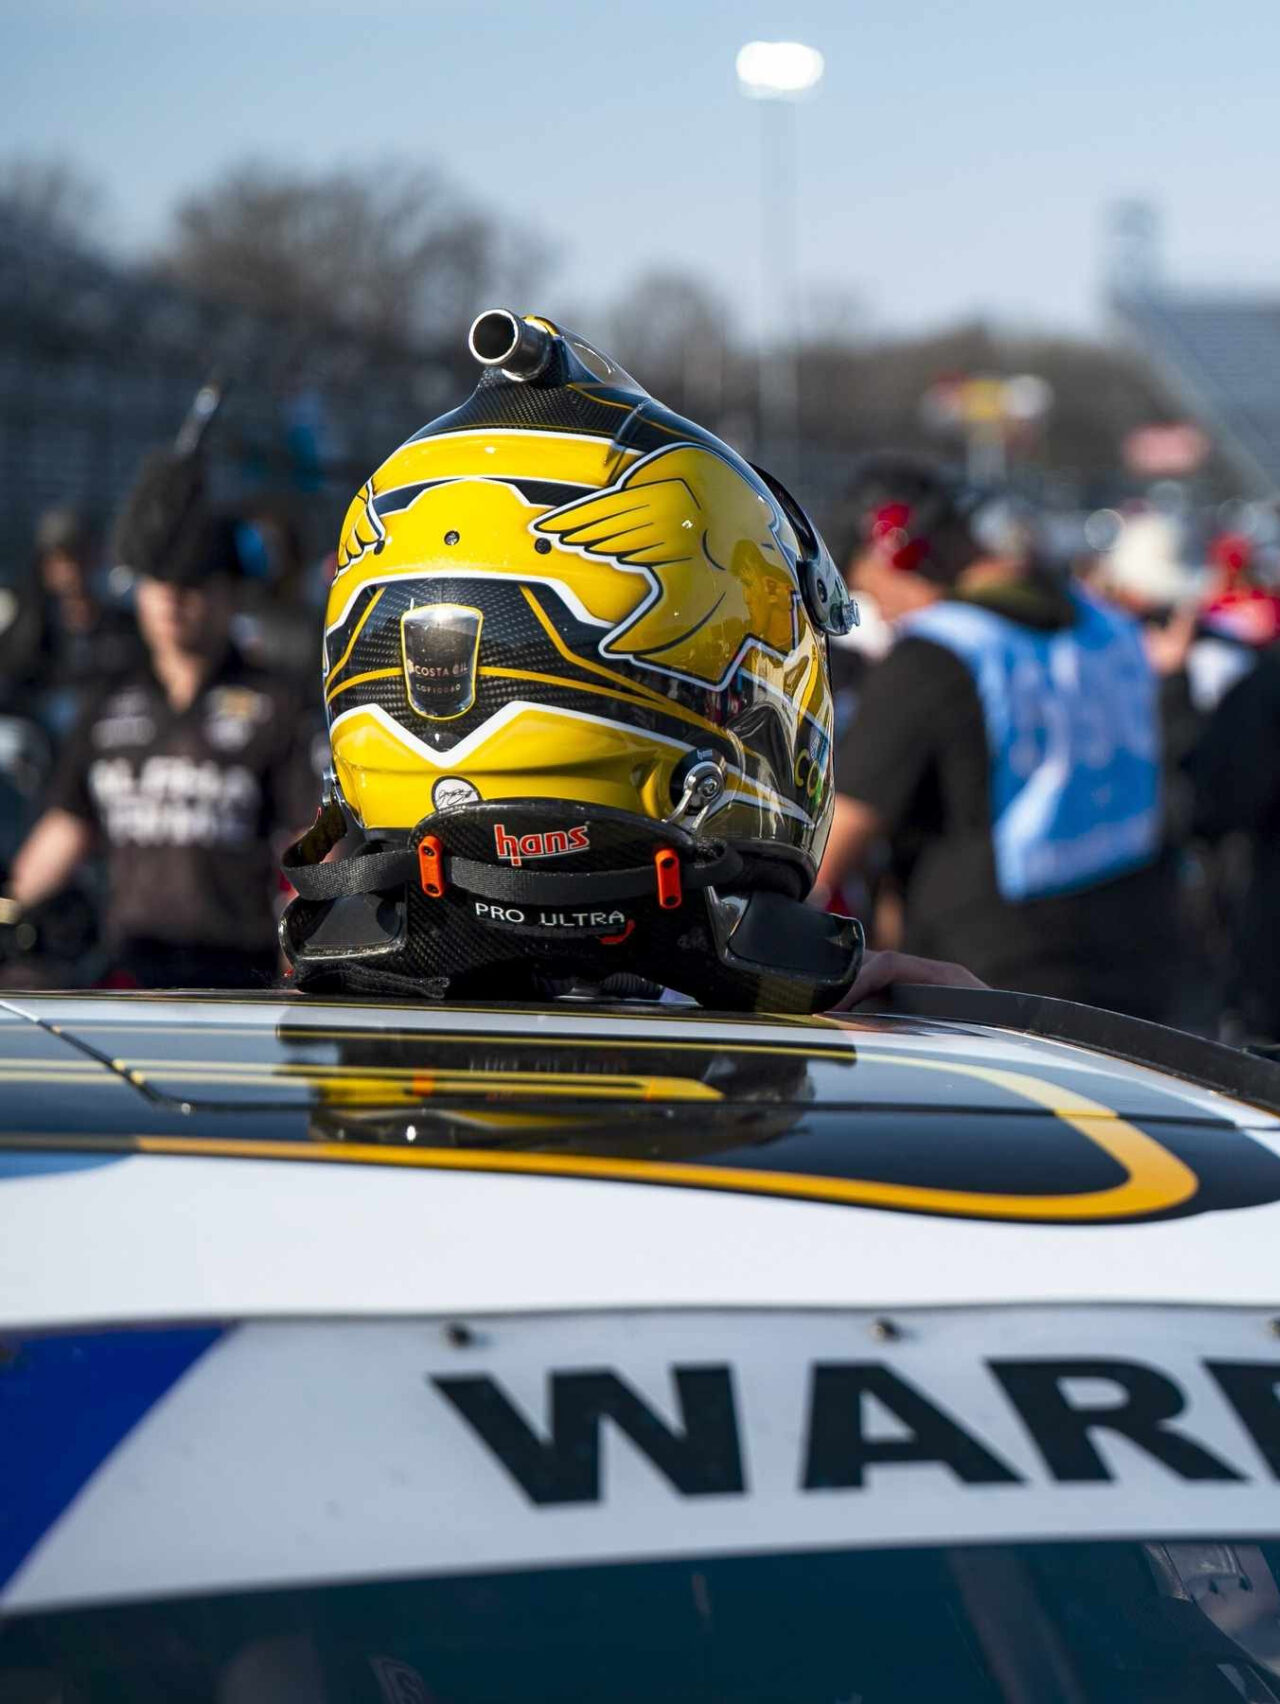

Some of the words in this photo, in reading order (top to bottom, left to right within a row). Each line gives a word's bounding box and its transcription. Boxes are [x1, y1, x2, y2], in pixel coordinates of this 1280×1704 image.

[414, 665, 449, 677] COSTA
[494, 823, 591, 867] hans
[475, 902, 525, 923] PRO
[540, 909, 625, 926] ULTRA
